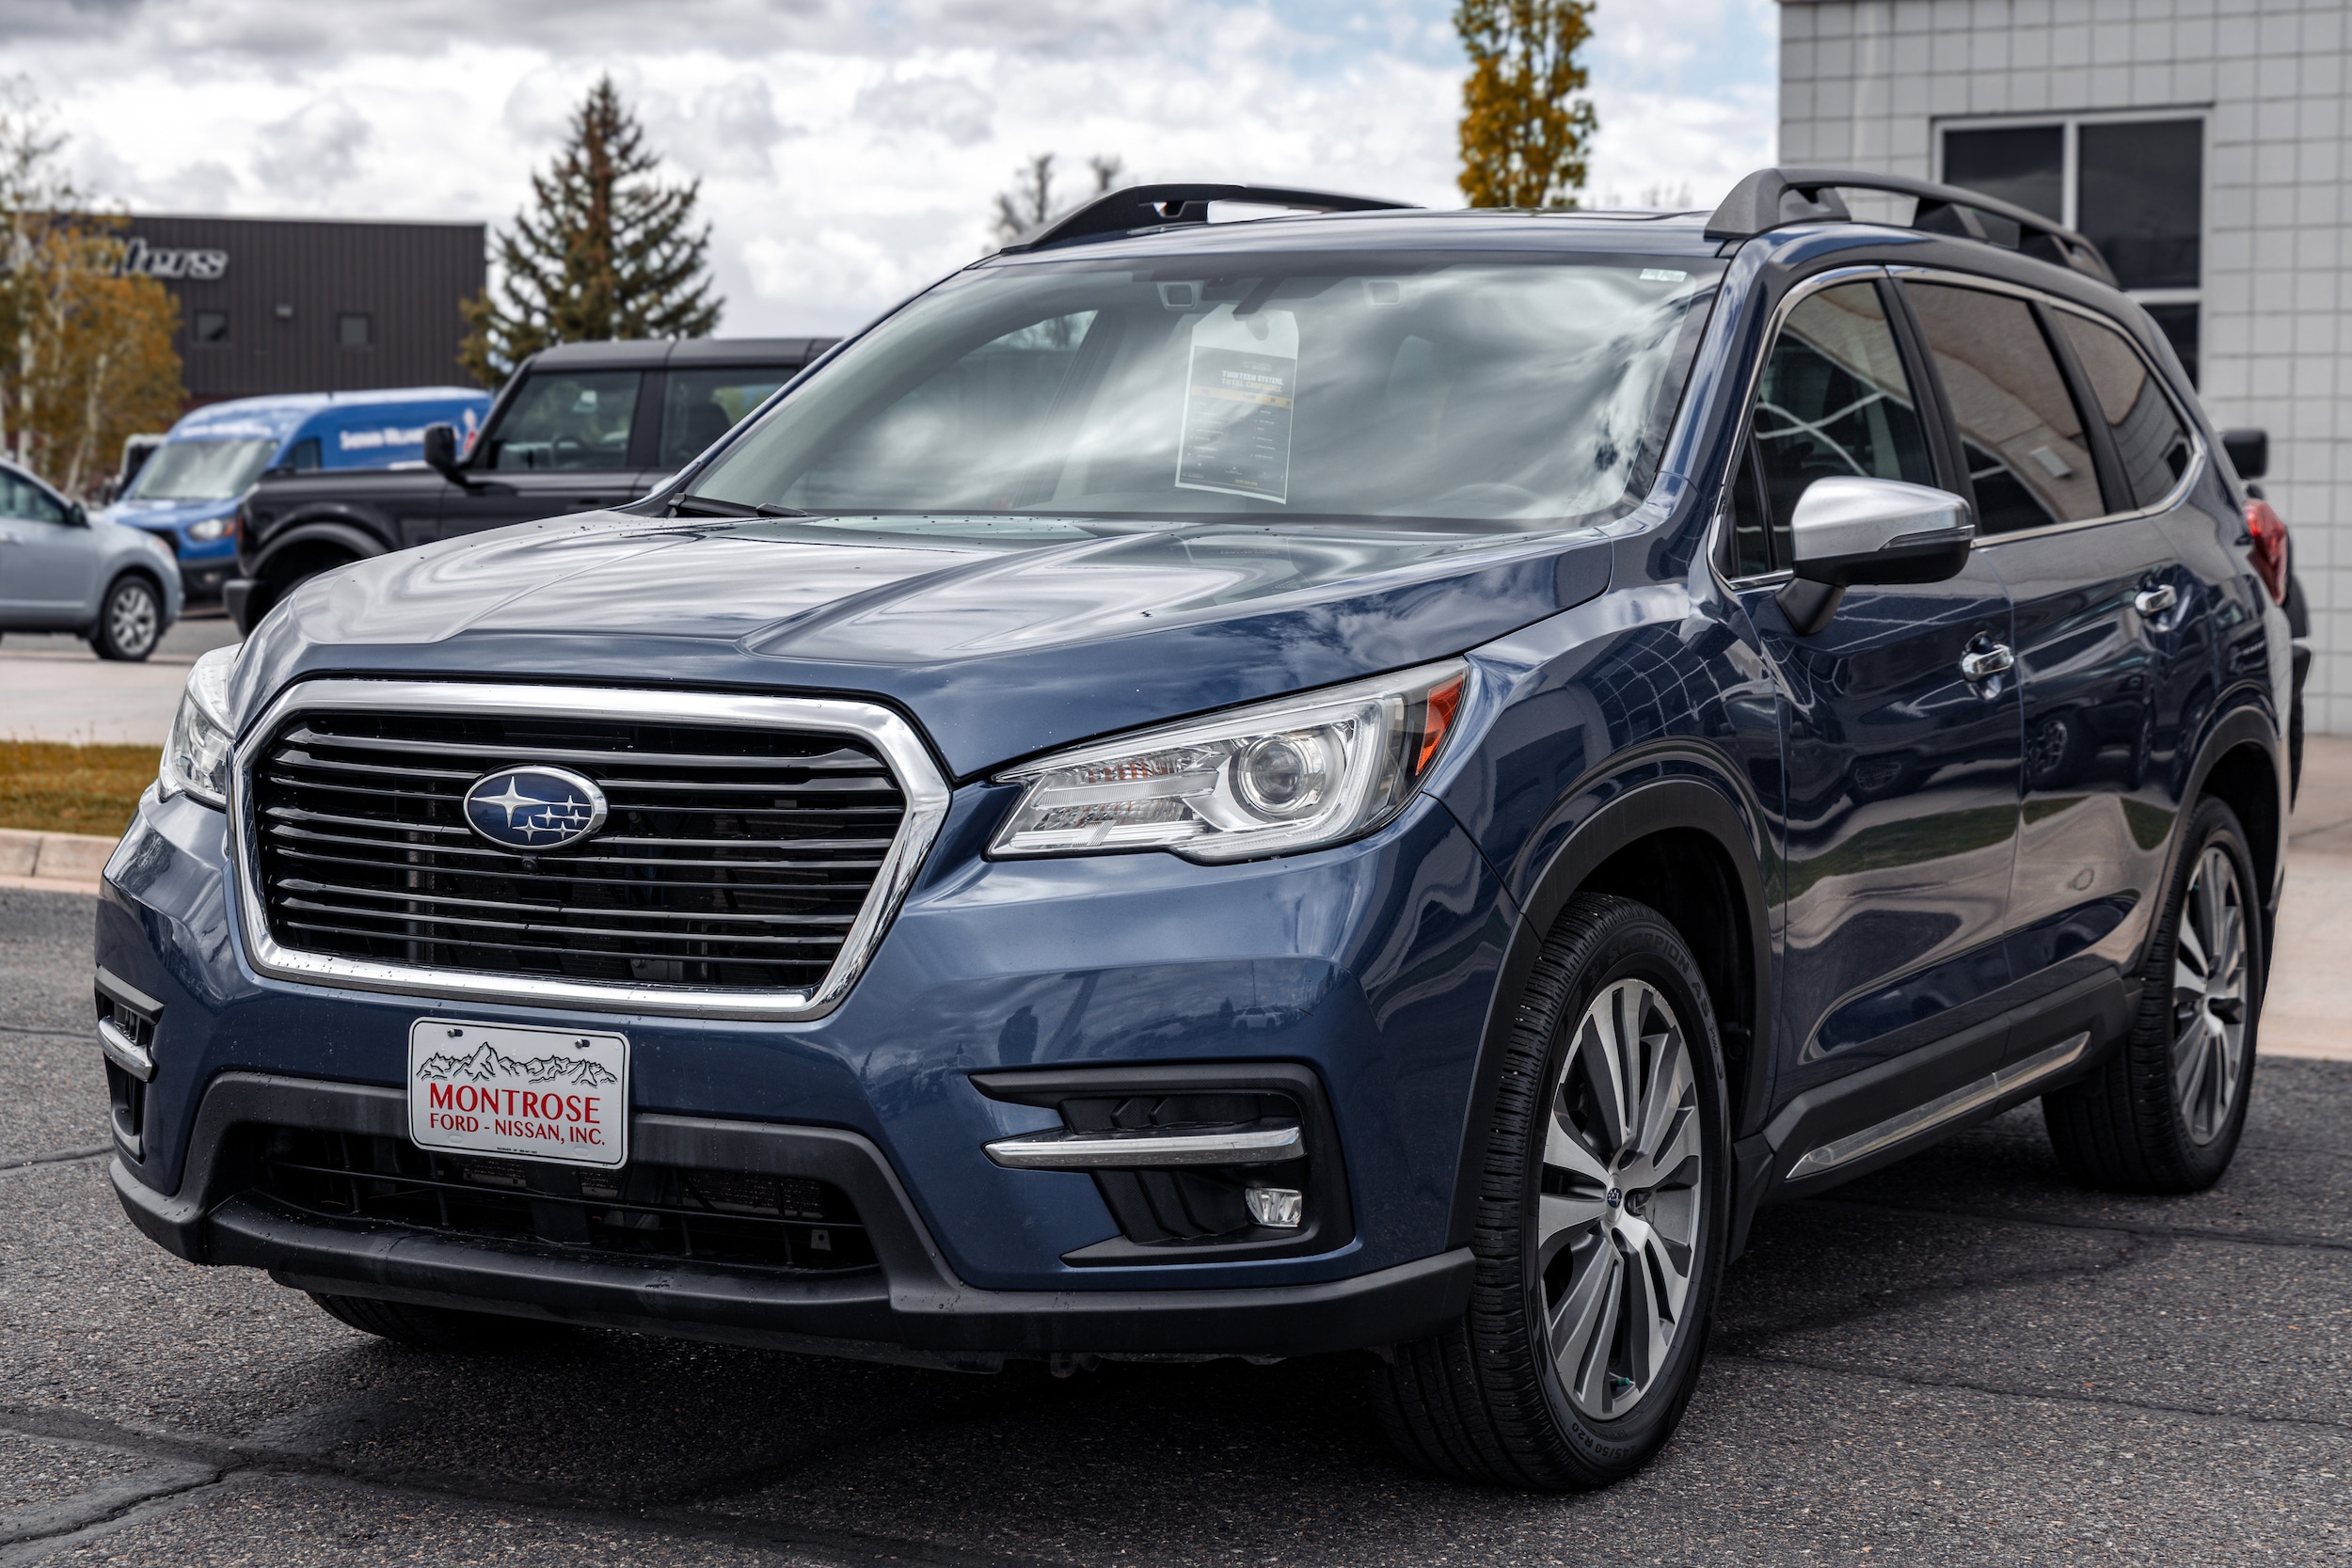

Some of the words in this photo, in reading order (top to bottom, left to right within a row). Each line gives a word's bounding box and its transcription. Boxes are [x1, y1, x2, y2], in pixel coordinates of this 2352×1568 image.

[1221, 378, 1245, 388] TOTAL
[1222, 370, 1257, 381] THIRTEEN
[1608, 933, 1690, 974] SCORPION
[1692, 981, 1710, 1018] AS
[430, 1083, 601, 1124] MONTROSE
[430, 1113, 479, 1132] FORD
[495, 1119, 564, 1145] NISSAN,
[569, 1126, 606, 1146] INC.
[1571, 1422, 1594, 1448] R20
[1595, 1444, 1637, 1460] 245/50
